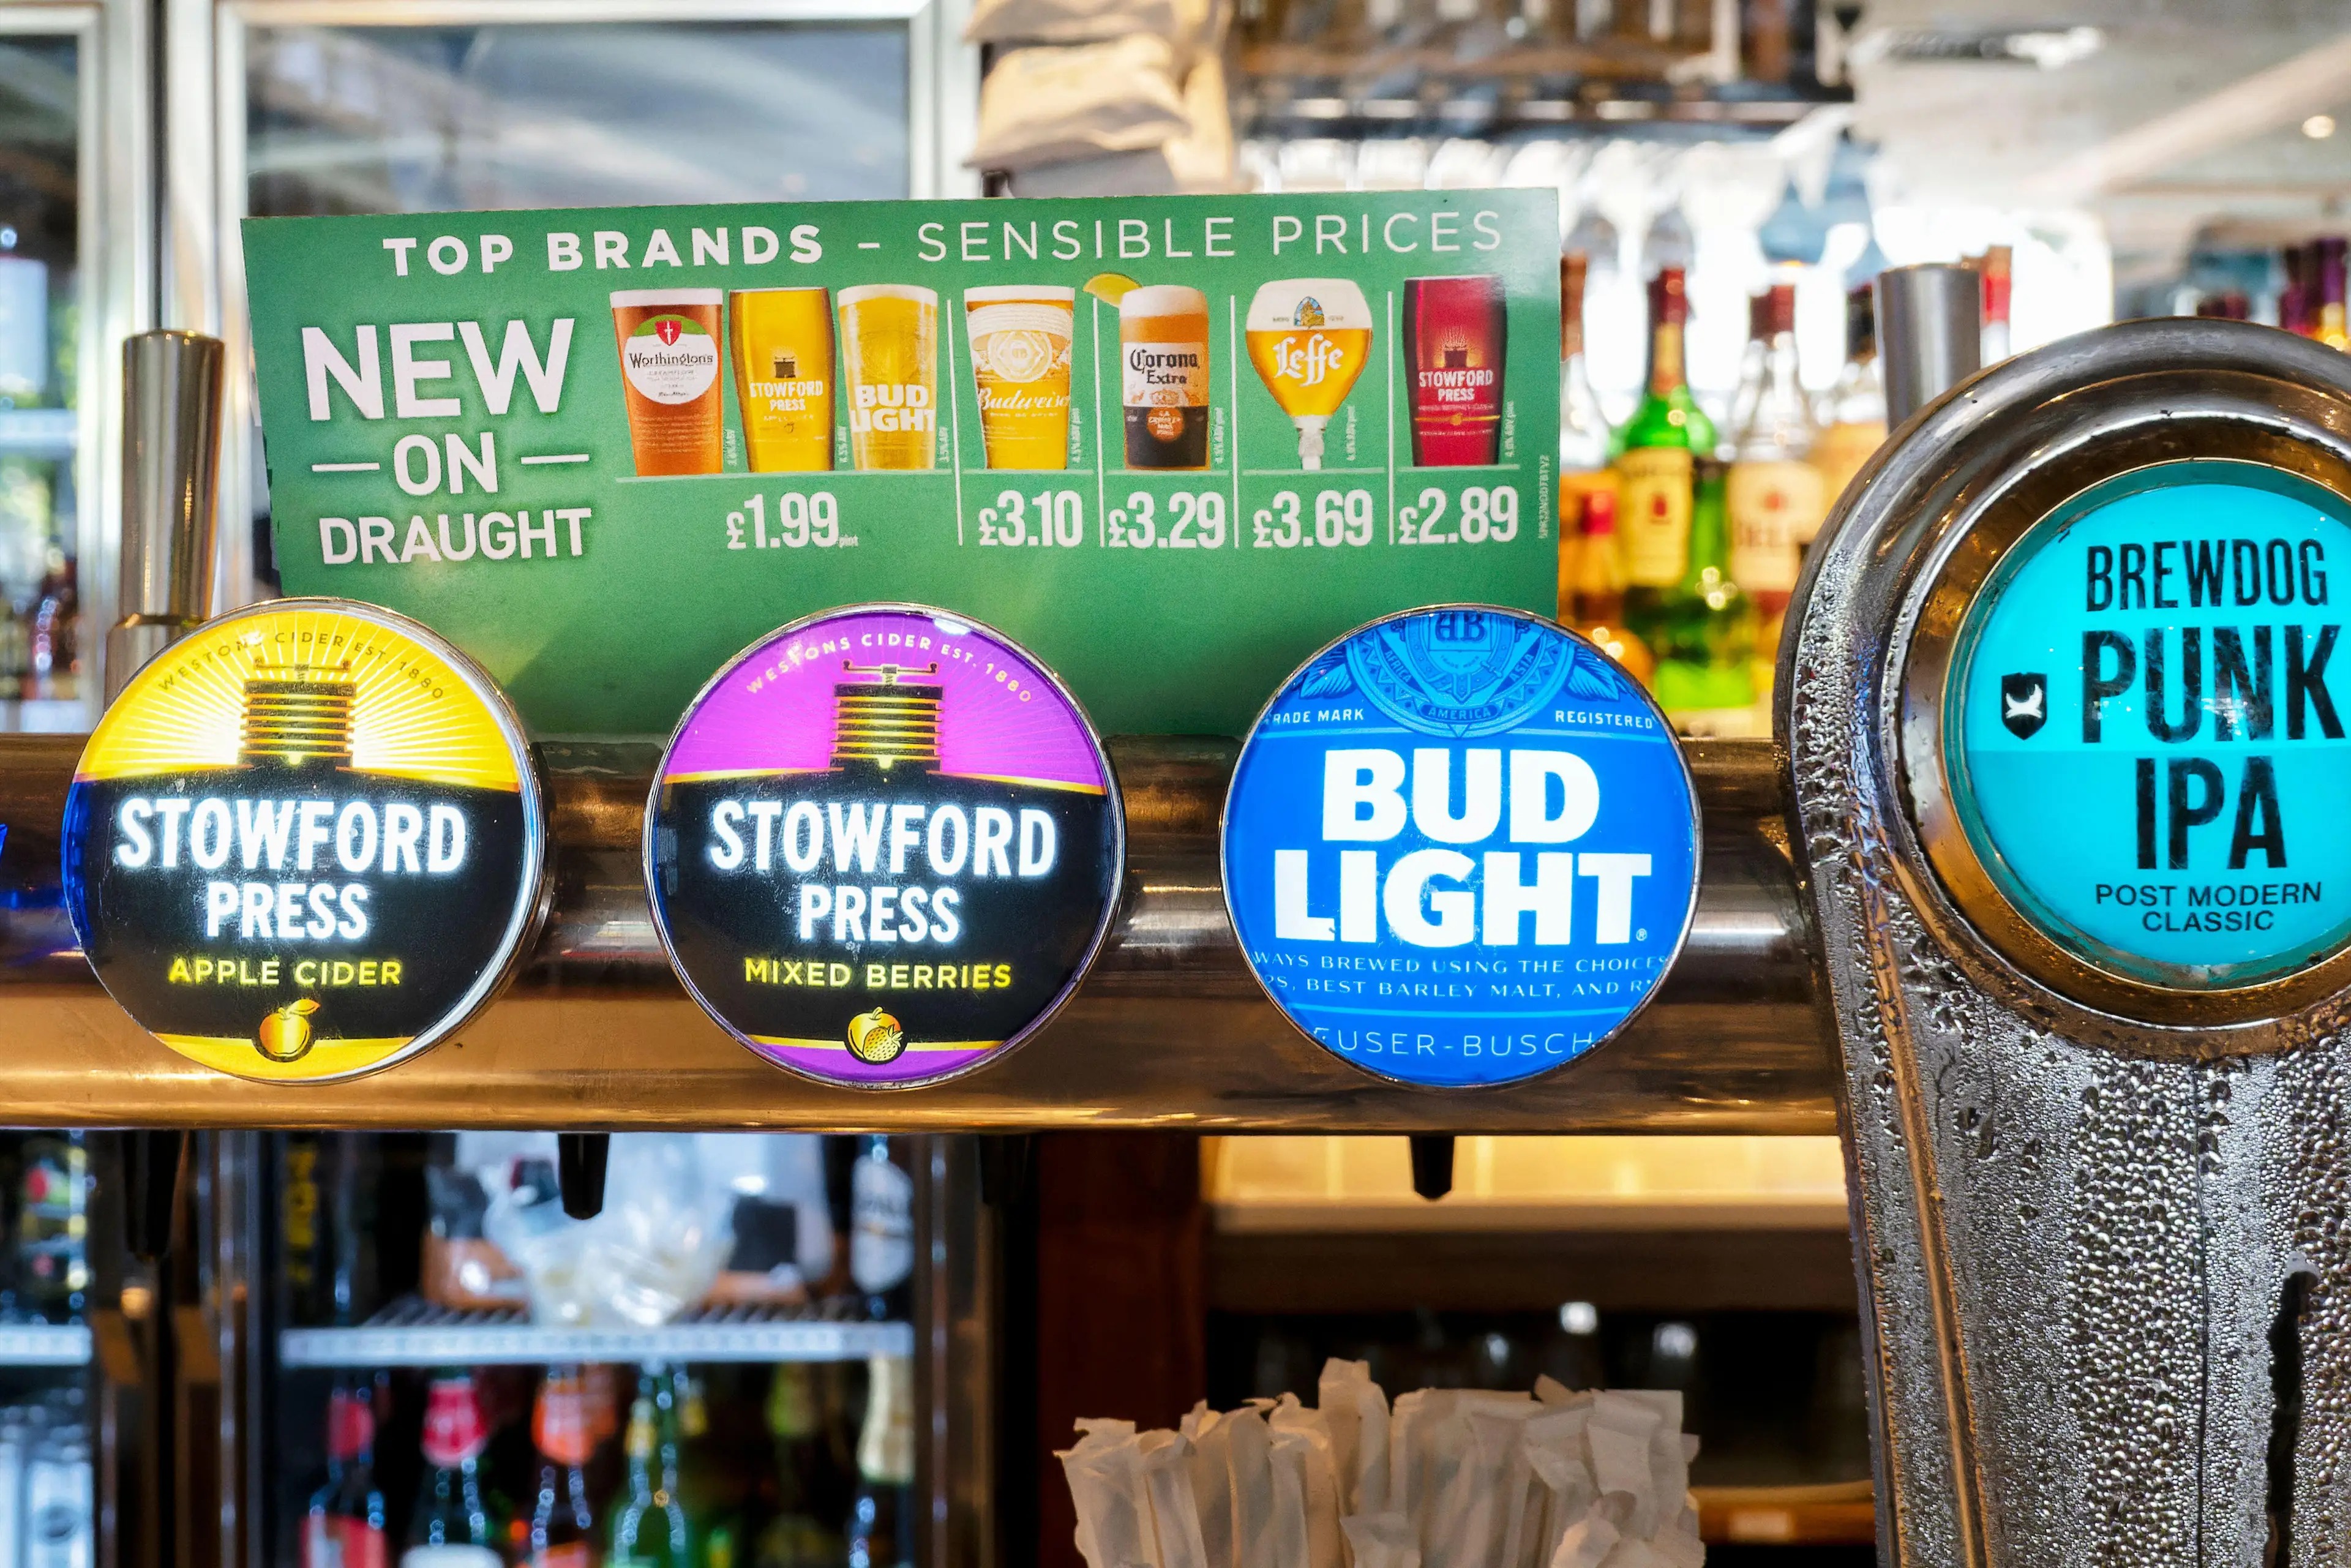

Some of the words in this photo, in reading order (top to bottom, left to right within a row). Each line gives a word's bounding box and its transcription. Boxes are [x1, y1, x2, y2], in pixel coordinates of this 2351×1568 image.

[383, 234, 514, 277] TOP
[547, 224, 822, 271] BRANDS
[918, 217, 1235, 262] SENSIBLE
[1273, 210, 1501, 256] PRICES
[302, 318, 575, 421] NEW
[749, 380, 823, 398] STOWFORD
[1130, 349, 1201, 374] Corona
[1146, 369, 1187, 384] Extra
[1272, 333, 1344, 388] Leffe
[1419, 369, 1494, 388] STOWFORD
[769, 399, 806, 411] PRESS
[856, 384, 929, 408] BUD
[1438, 388, 1475, 402] PRESS
[393, 432, 498, 496] ON
[319, 508, 592, 565] DRAUGHT
[726, 491, 839, 550] £1.99
[978, 490, 1083, 548] £3.10
[1108, 490, 1226, 549] £3.29
[1253, 489, 1373, 548] £3.69
[1398, 486, 1518, 545] £2.89
[2086, 538, 2328, 612] BREWDOG
[274, 631, 344, 647] CIDER
[354, 642, 389, 664] EST.
[399, 659, 444, 699] 1880
[746, 636, 850, 694] WESTONS
[861, 632, 932, 650] CIDER
[940, 643, 978, 667] EST.
[986, 662, 1032, 702] 1880
[1384, 649, 1413, 683] AFRICA
[1510, 653, 1535, 683] ASIA
[2082, 625, 2347, 744] PUNK
[1267, 710, 1311, 725] RADE
[1318, 708, 1364, 722] MARK
[1428, 706, 1491, 721] AMERICA
[1555, 710, 1653, 729] REGISTERED
[1322, 748, 1600, 844] BUD
[2135, 756, 2287, 870] IPA
[117, 796, 467, 874] STOWFORD
[710, 798, 1056, 877] STOWFORD
[204, 880, 369, 940] PRESS
[798, 885, 959, 943] PRESS
[1275, 849, 1652, 947] LIGHT
[2096, 883, 2177, 907] POST
[2188, 881, 2322, 907] MODERN
[2142, 910, 2274, 932] CLASSIC
[168, 958, 280, 986] APPLE
[293, 959, 402, 987] CIDER
[744, 958, 852, 988] MIXED
[866, 962, 1011, 990] BERRIES
[1307, 978, 1367, 994] BEST
[1379, 982, 1477, 997] BARLEY
[1491, 984, 1561, 999] MALT,
[1572, 981, 1619, 996] AND
[1630, 980, 1652, 992] R
[1321, 956, 1420, 972] BREWED
[1432, 959, 1507, 973] USING
[1518, 960, 1564, 973] THE
